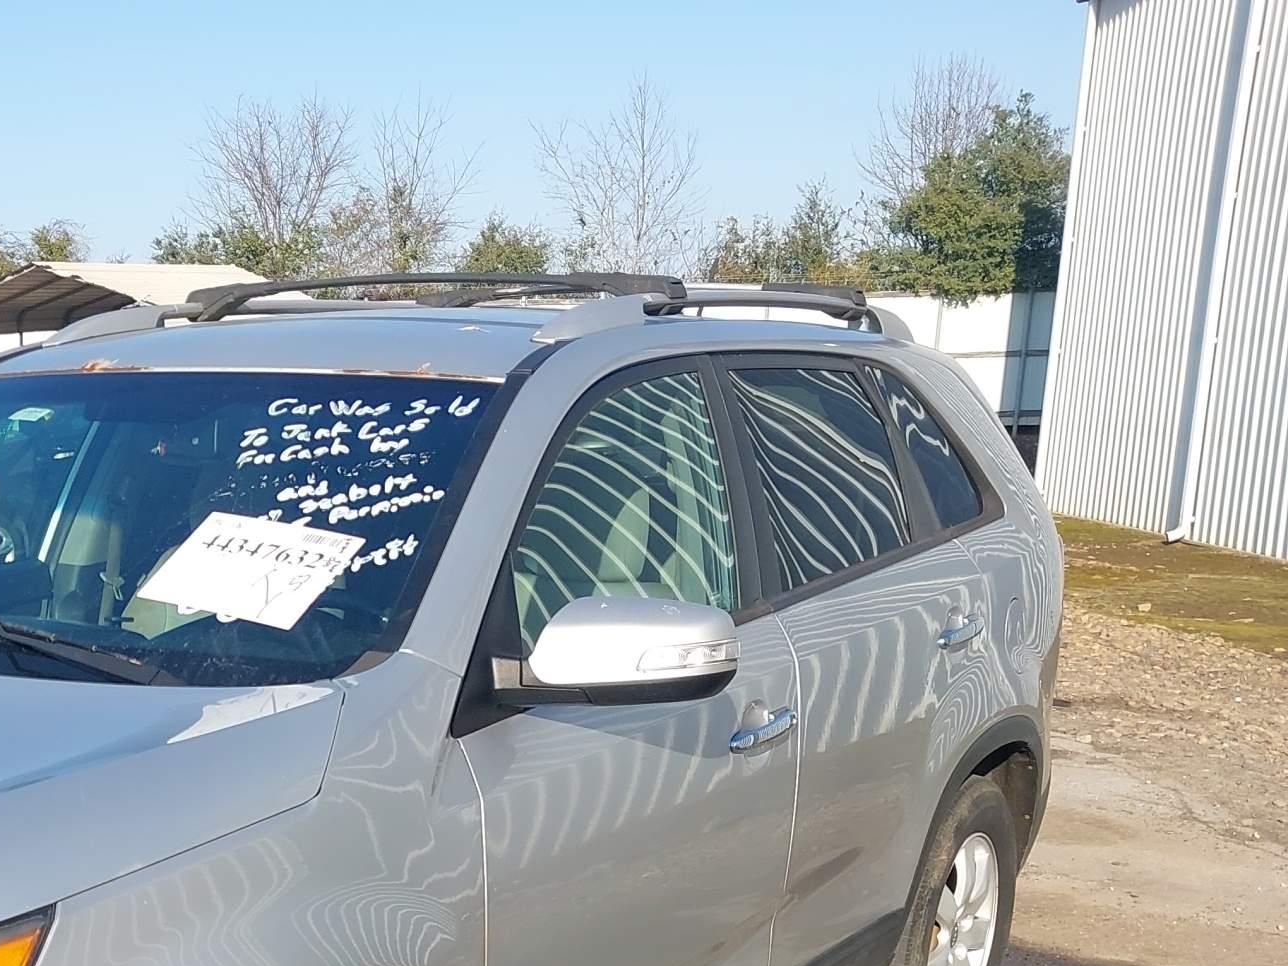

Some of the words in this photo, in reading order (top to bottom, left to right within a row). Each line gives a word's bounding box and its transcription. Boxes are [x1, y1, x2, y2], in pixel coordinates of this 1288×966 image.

[267, 398, 322, 416] Car
[329, 399, 391, 417] Was
[202, 534, 325, 569] 44347632
